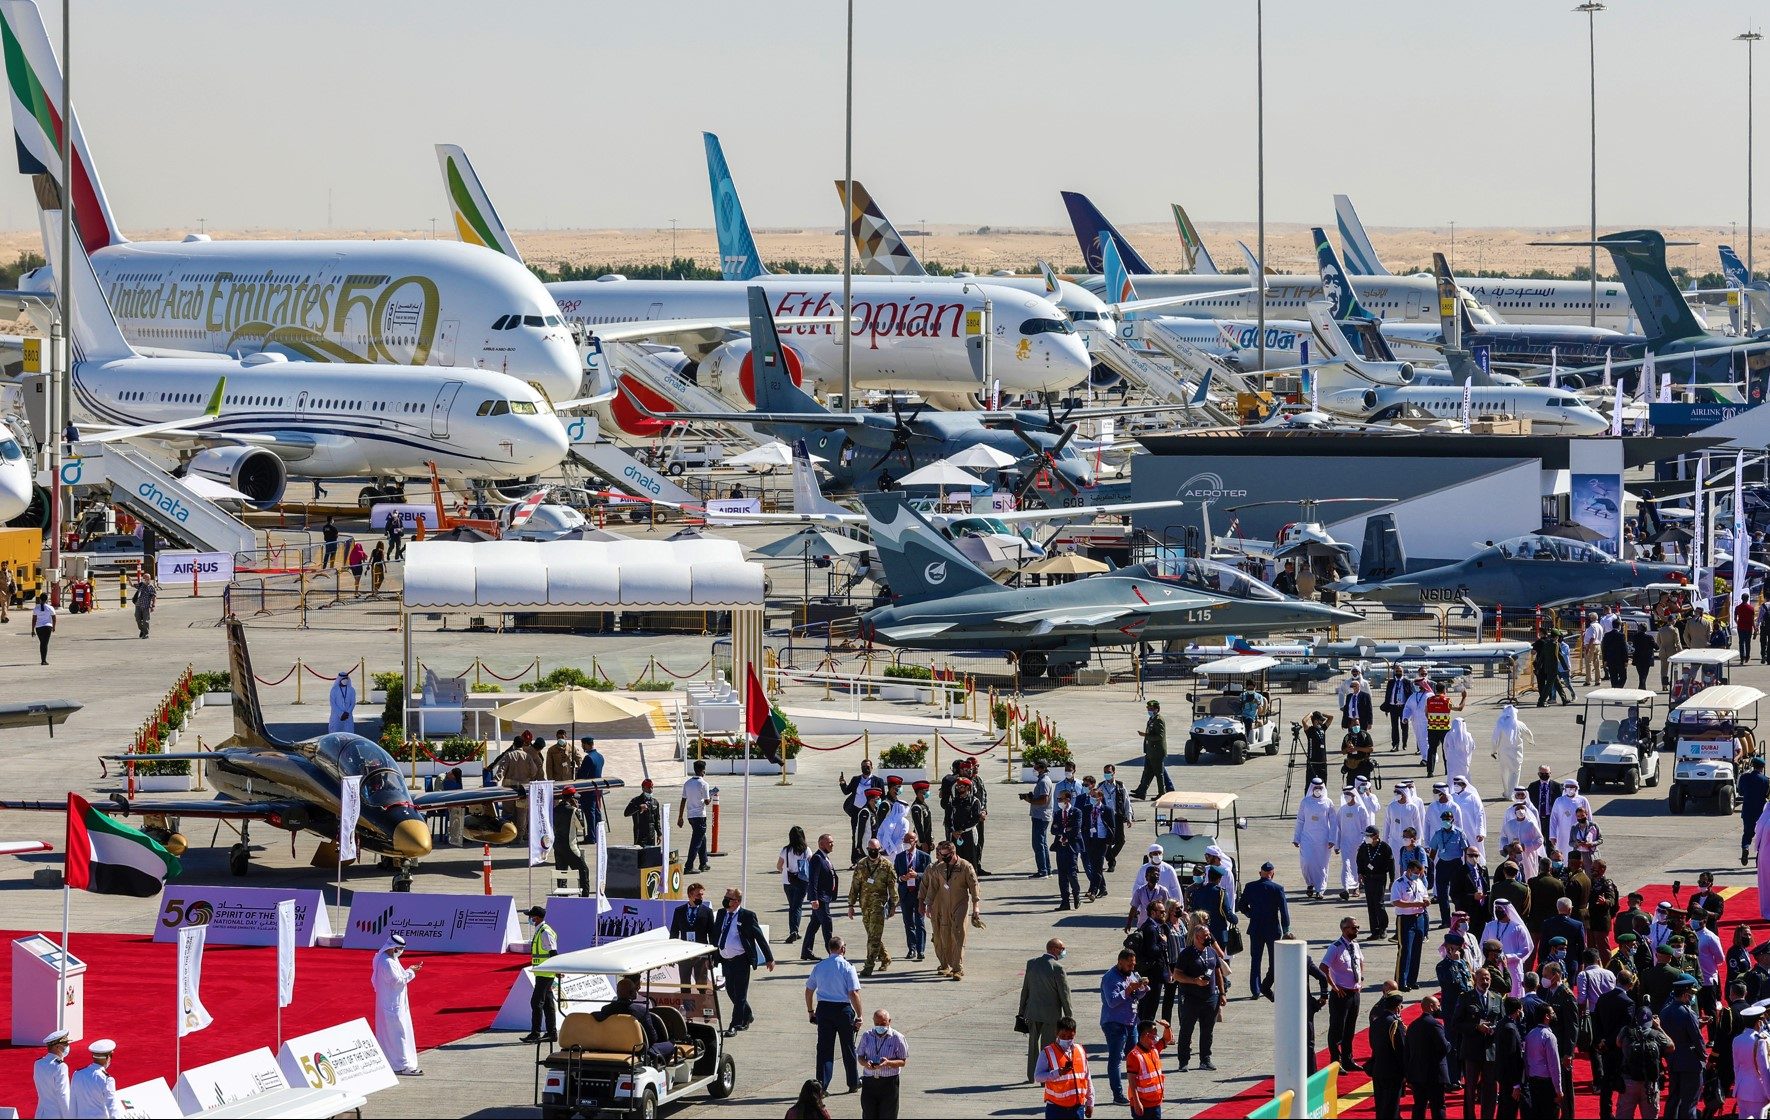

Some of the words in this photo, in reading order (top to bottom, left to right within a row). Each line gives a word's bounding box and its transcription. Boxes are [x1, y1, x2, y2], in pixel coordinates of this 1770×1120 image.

[724, 255, 748, 274] 777
[1491, 285, 1555, 299] السعودية
[109, 282, 165, 319] United
[161, 282, 205, 321] Arab
[206, 269, 335, 335] Emirates
[774, 291, 964, 350] Ethopian
[23, 350, 39, 362] S803
[663, 375, 687, 394] dnata
[1690, 408, 1721, 416] AIRLINK
[623, 463, 661, 496] dnata
[1185, 489, 1247, 498] AEROTER
[138, 482, 190, 523] dnata
[1062, 497, 1085, 508] 608
[385, 512, 426, 521] ARBUS
[173, 562, 219, 574] AIRBUS
[1188, 609, 1212, 622] L15
[162, 899, 214, 927] 50
[215, 910, 244, 919] SPIRIT
[258, 912, 276, 920] THE
[213, 918, 245, 926] NATIONAL
[390, 929, 405, 937] THE
[405, 930, 443, 938] EMIRATES
[331, 1057, 348, 1068] SPIRIT
[346, 1055, 354, 1064] OF
[353, 1052, 364, 1061] THE
[363, 1048, 379, 1060] UNION
